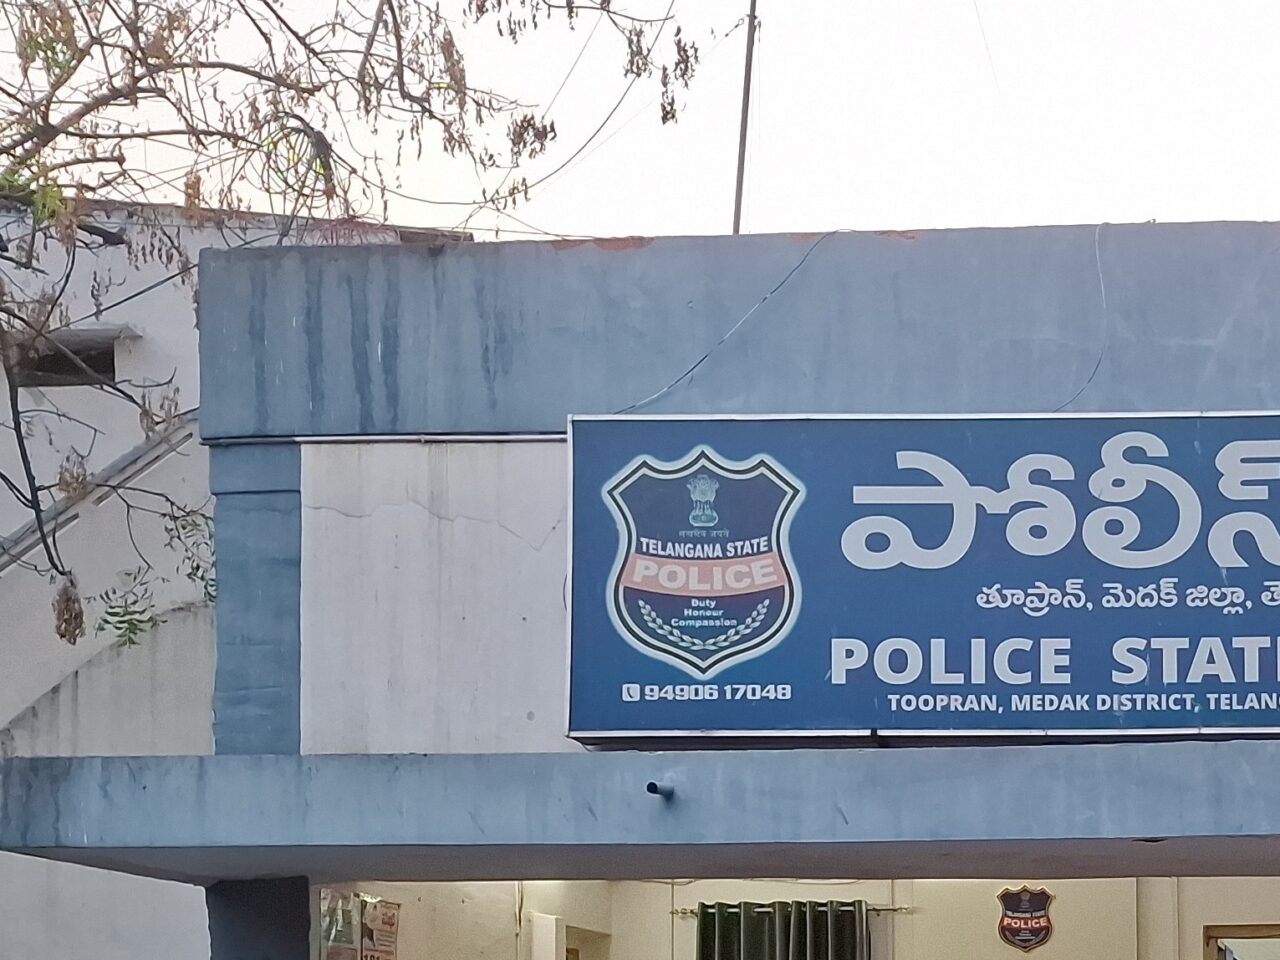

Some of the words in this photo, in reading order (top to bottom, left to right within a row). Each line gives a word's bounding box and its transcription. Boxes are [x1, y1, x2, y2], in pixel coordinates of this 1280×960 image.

[639, 536, 723, 558] TELANGANA
[726, 535, 769, 557] STATE
[632, 558, 778, 591] POLICE
[690, 598, 717, 609] Duty
[975, 578, 1094, 617] తూప్రాన్,
[1101, 577, 1179, 609] మెదక్
[1185, 581, 1253, 615] జిల్లా,
[670, 617, 738, 628] Compassion
[683, 608, 724, 617] Honour
[830, 636, 1072, 686] POLICE
[644, 684, 718, 701] 94906
[723, 683, 792, 701] 17048
[887, 693, 1004, 715] TOOPRAN,
[1010, 692, 1090, 712] MEDAK
[1096, 692, 1200, 714] DISTRICT,
[1003, 917, 1048, 928] POLICE
